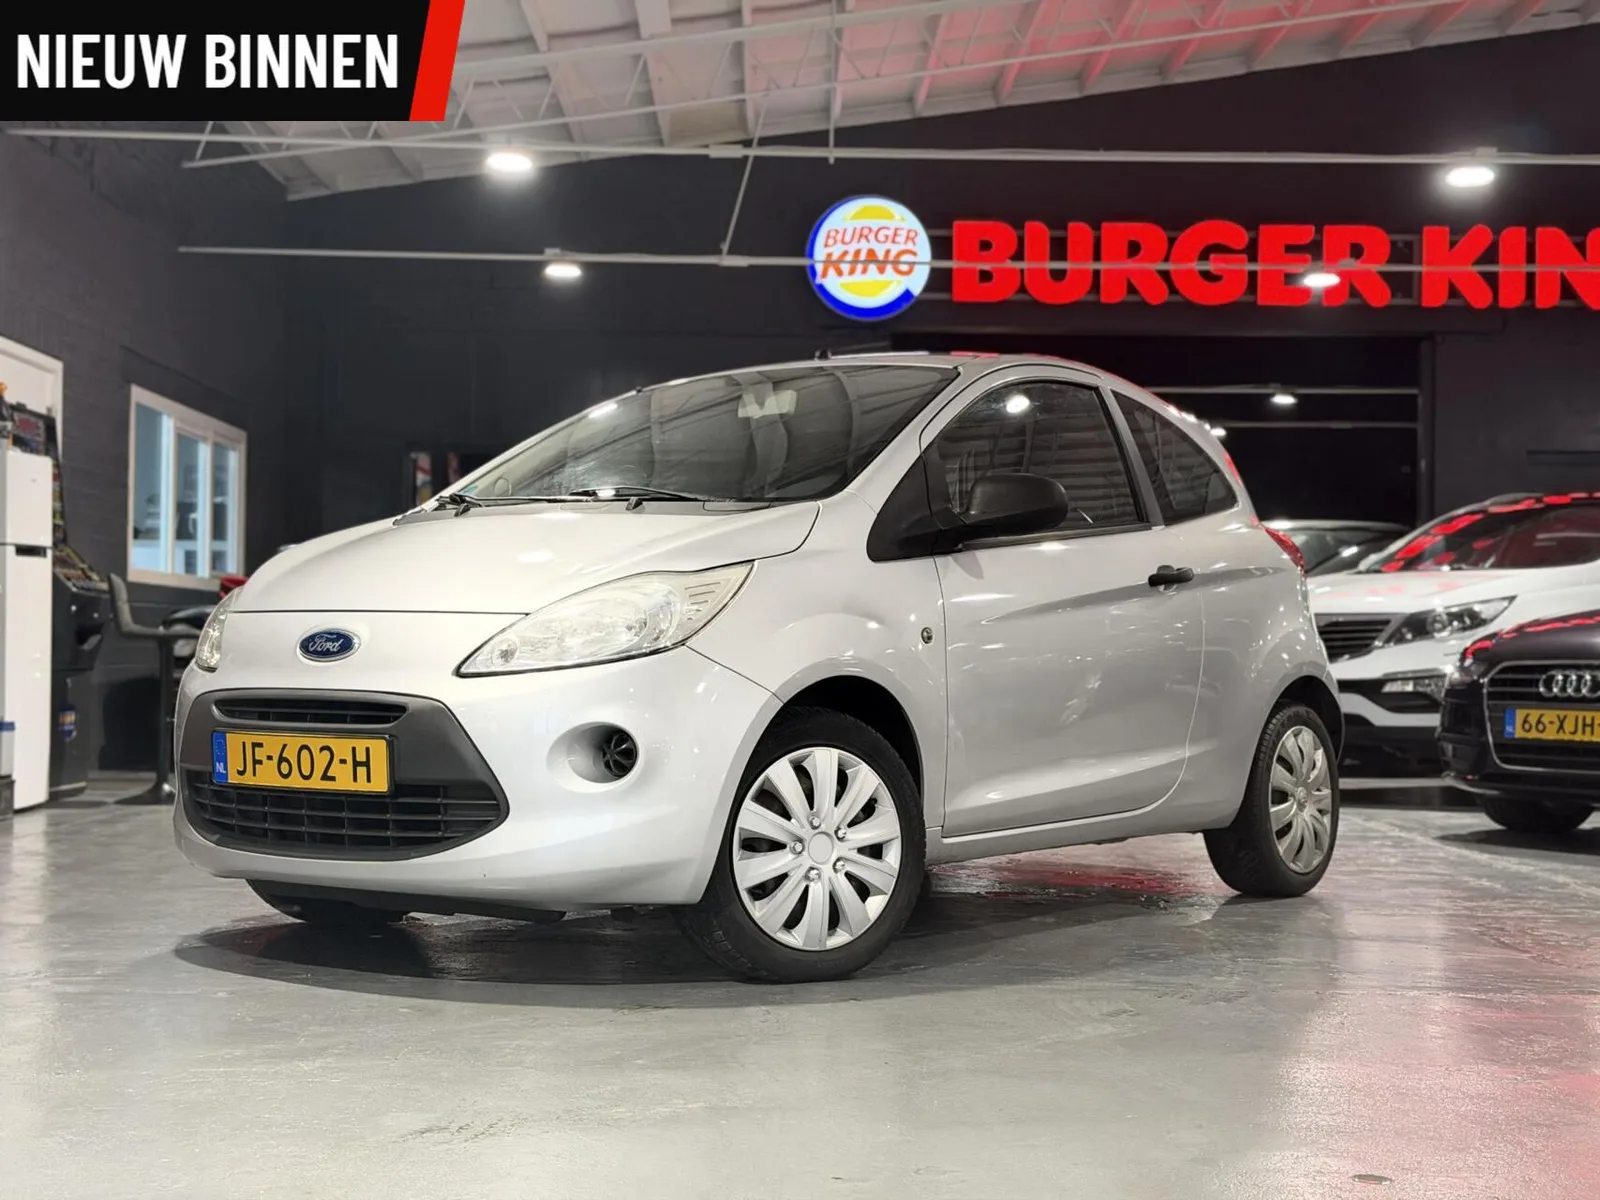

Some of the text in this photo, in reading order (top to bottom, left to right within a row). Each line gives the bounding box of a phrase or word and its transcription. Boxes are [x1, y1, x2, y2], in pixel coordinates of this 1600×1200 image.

[823, 226, 918, 248] BURGER
[820, 247, 918, 279] KING
[952, 220, 1600, 310] BURGER KIN
[308, 633, 344, 652] Ford
[216, 762, 226, 774] NL
[236, 741, 371, 783] JF-602-H
